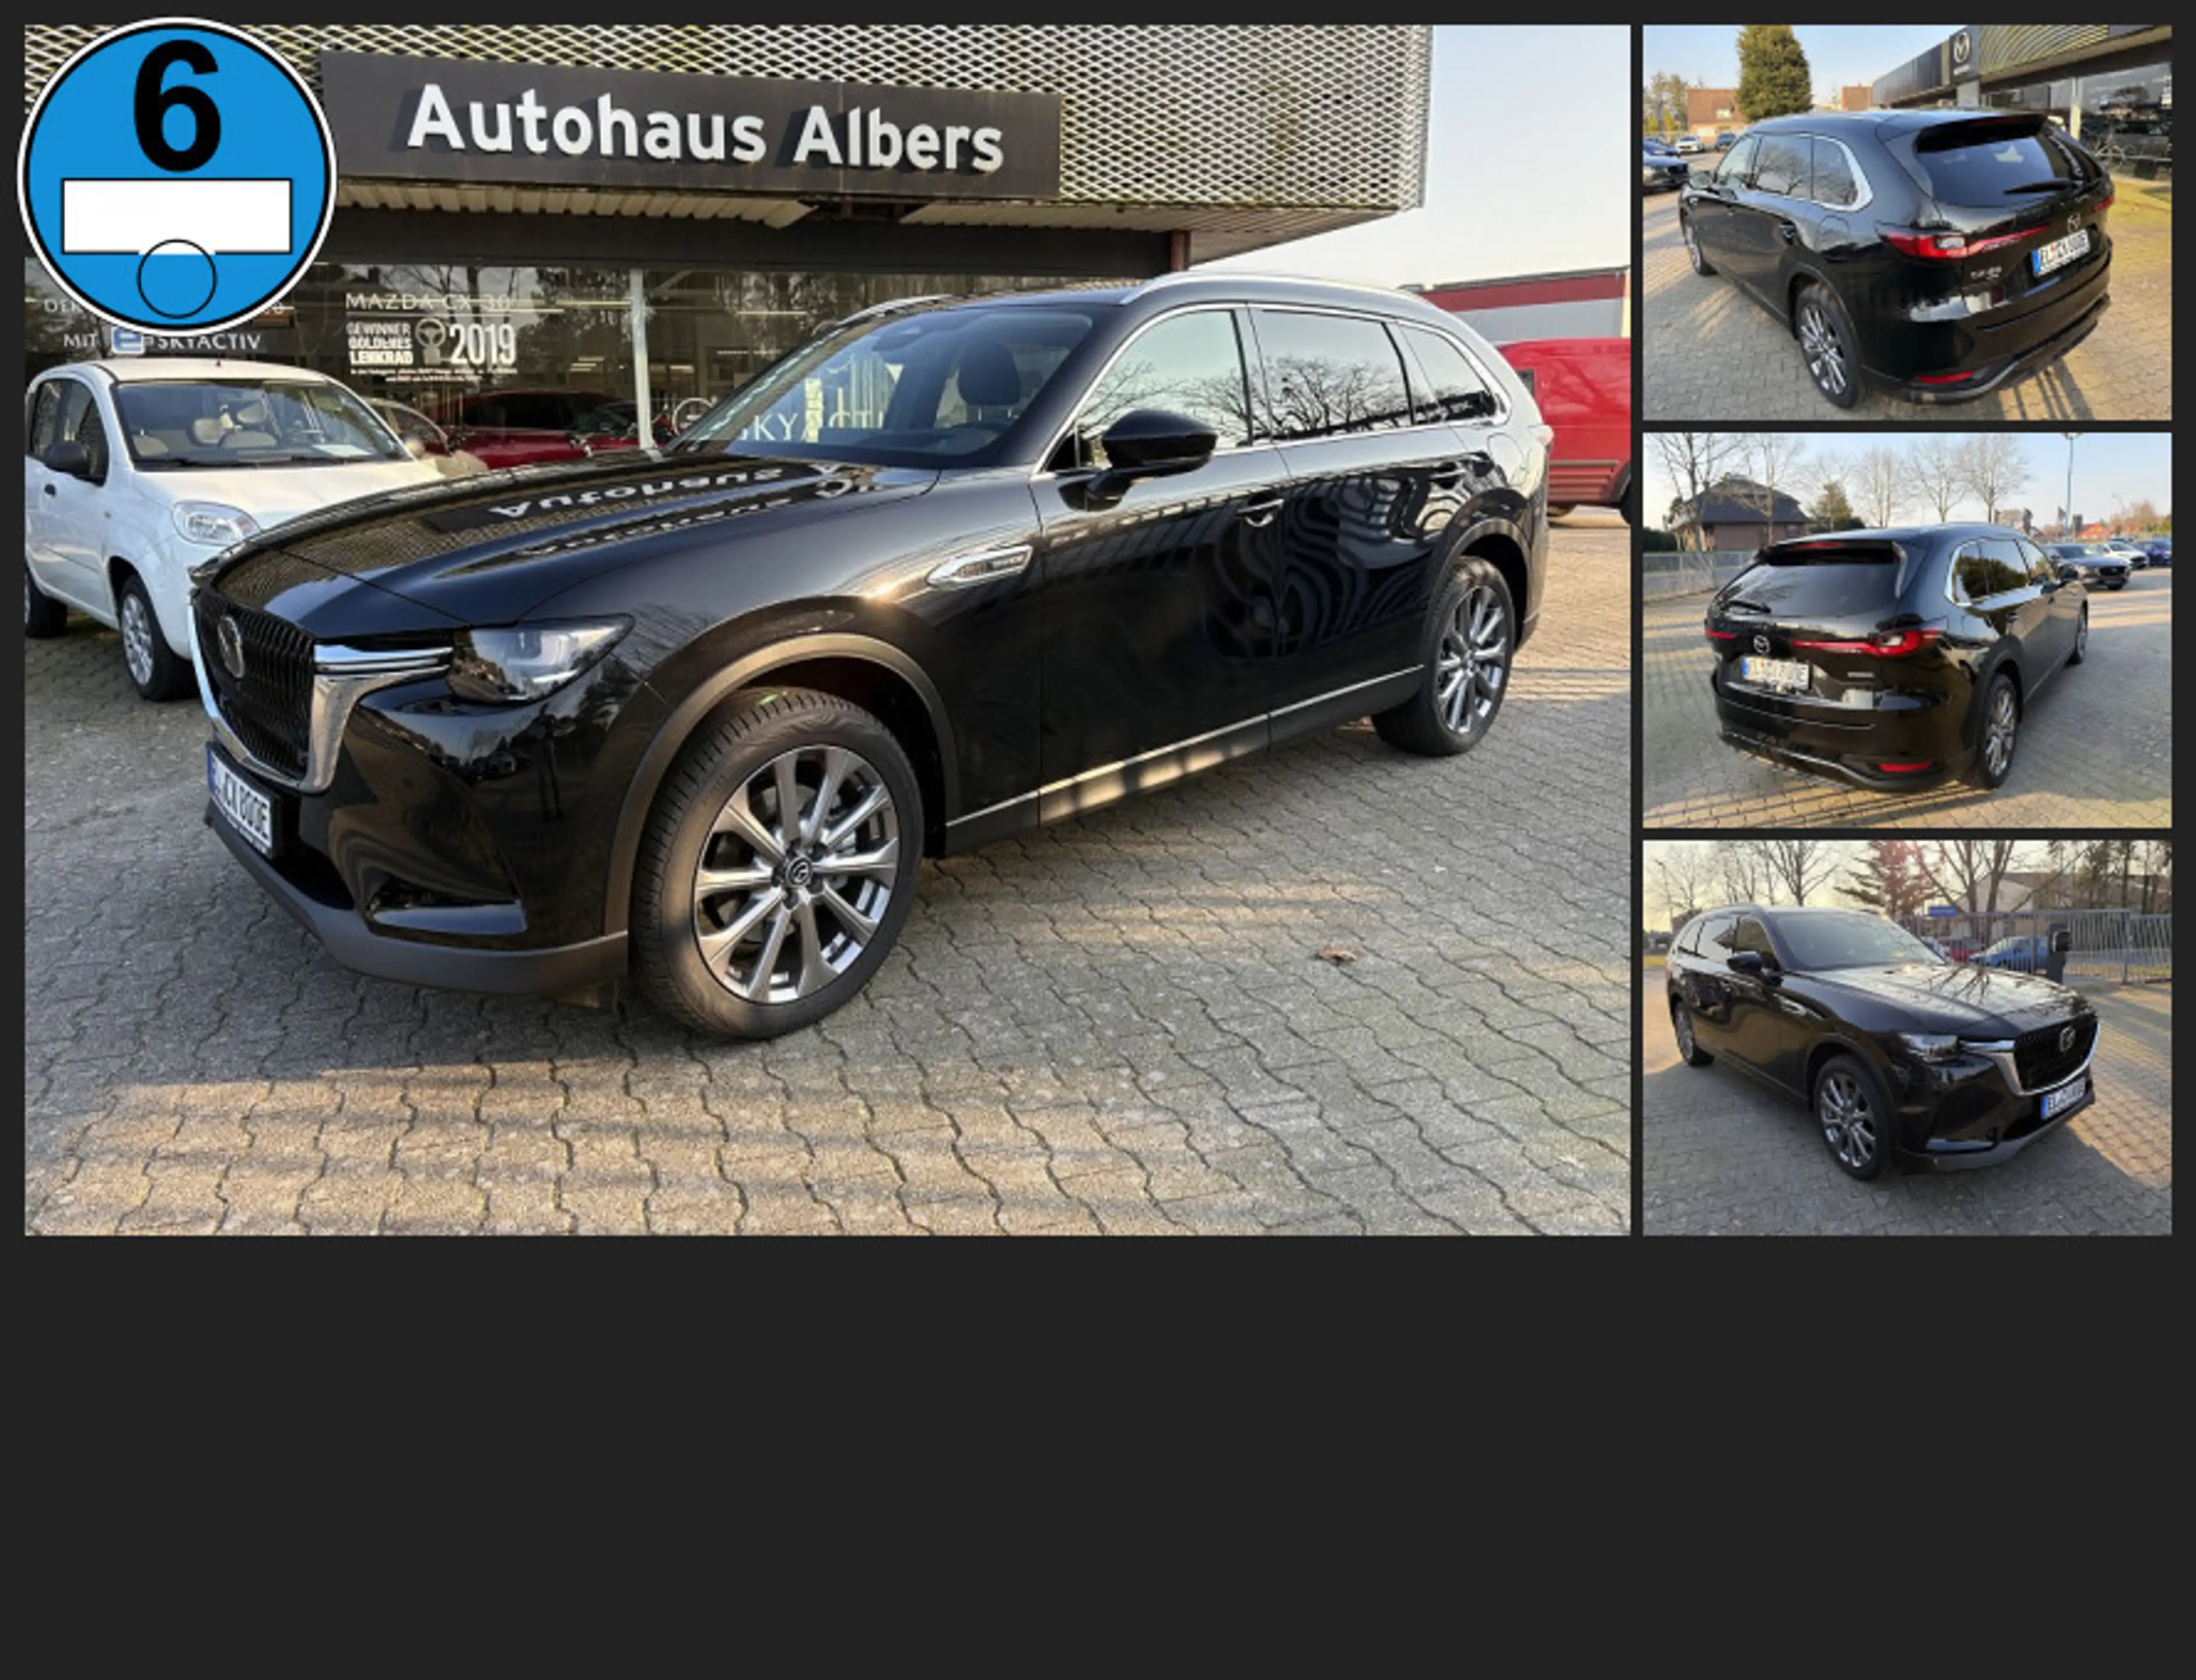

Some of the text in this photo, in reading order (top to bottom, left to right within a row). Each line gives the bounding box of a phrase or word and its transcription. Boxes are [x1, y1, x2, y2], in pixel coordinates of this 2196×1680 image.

[408, 83, 1003, 173] Autohaus Albers
[345, 293, 433, 310] MAZDA
[64, 333, 98, 347] MIT
[449, 323, 517, 365] 2019
[350, 351, 414, 365] LENKRAD
